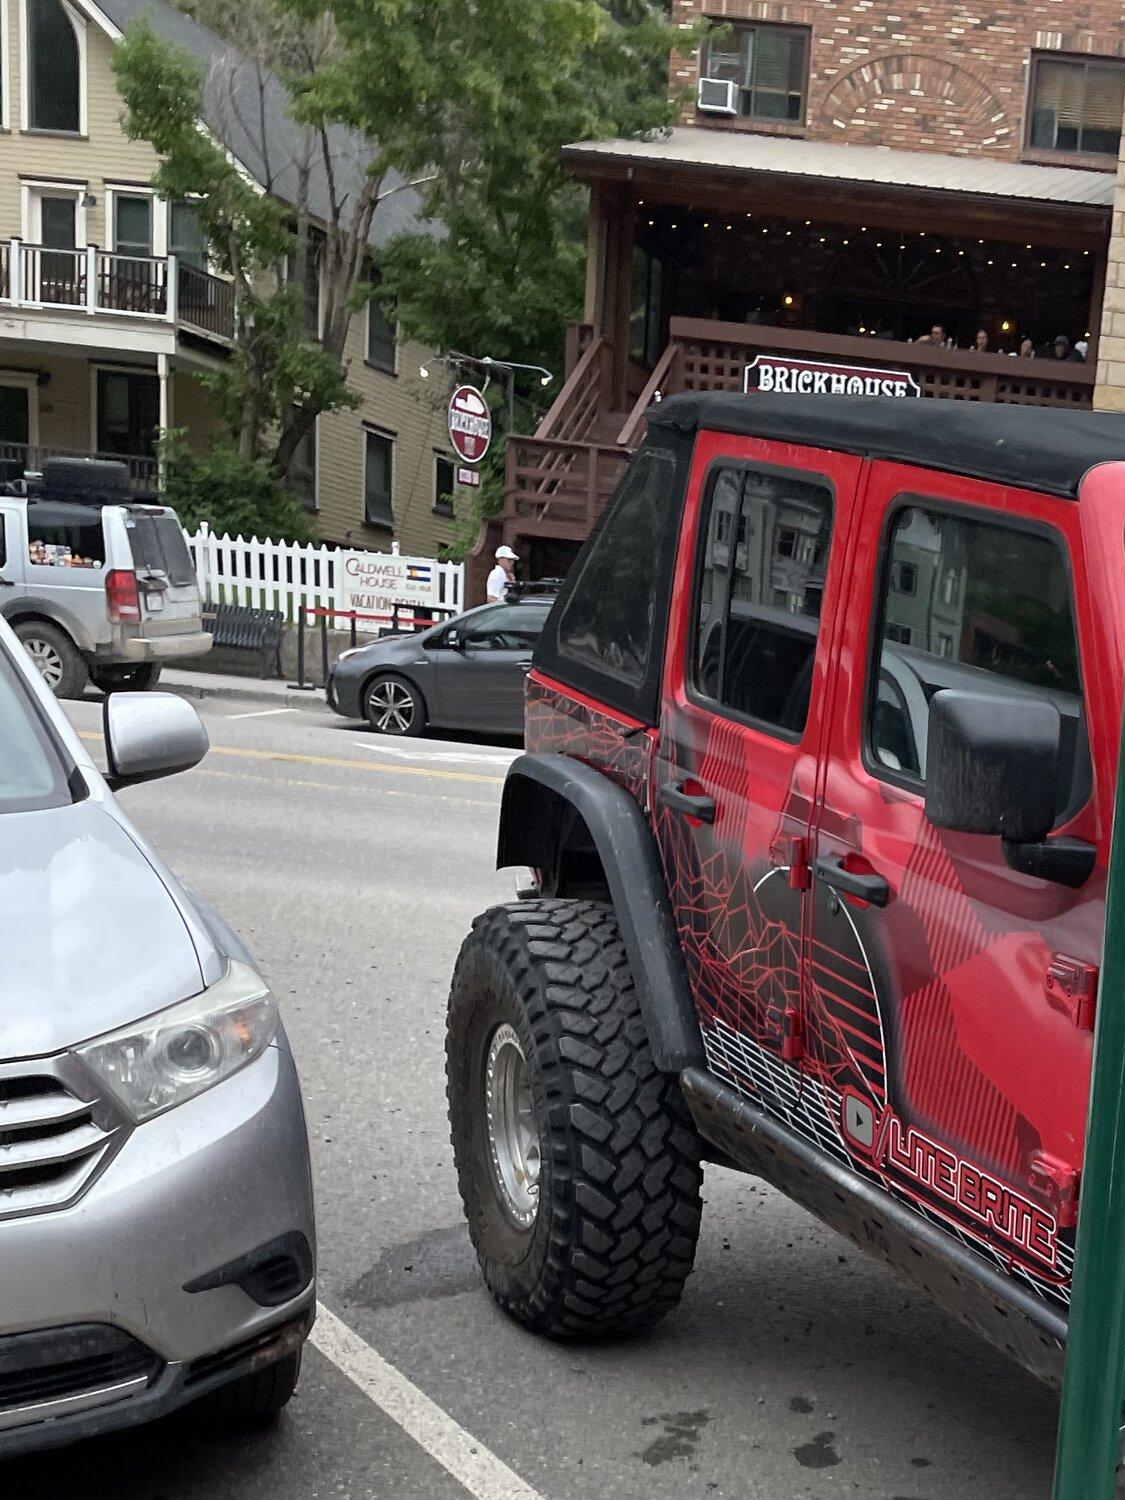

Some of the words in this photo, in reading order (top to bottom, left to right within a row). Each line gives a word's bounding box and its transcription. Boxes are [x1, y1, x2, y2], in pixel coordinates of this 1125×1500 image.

[757, 364, 908, 398] BRICKHOUSE
[345, 557, 406, 578] CALDWELL
[360, 576, 397, 590] HOUSE
[350, 593, 392, 611] VACATION
